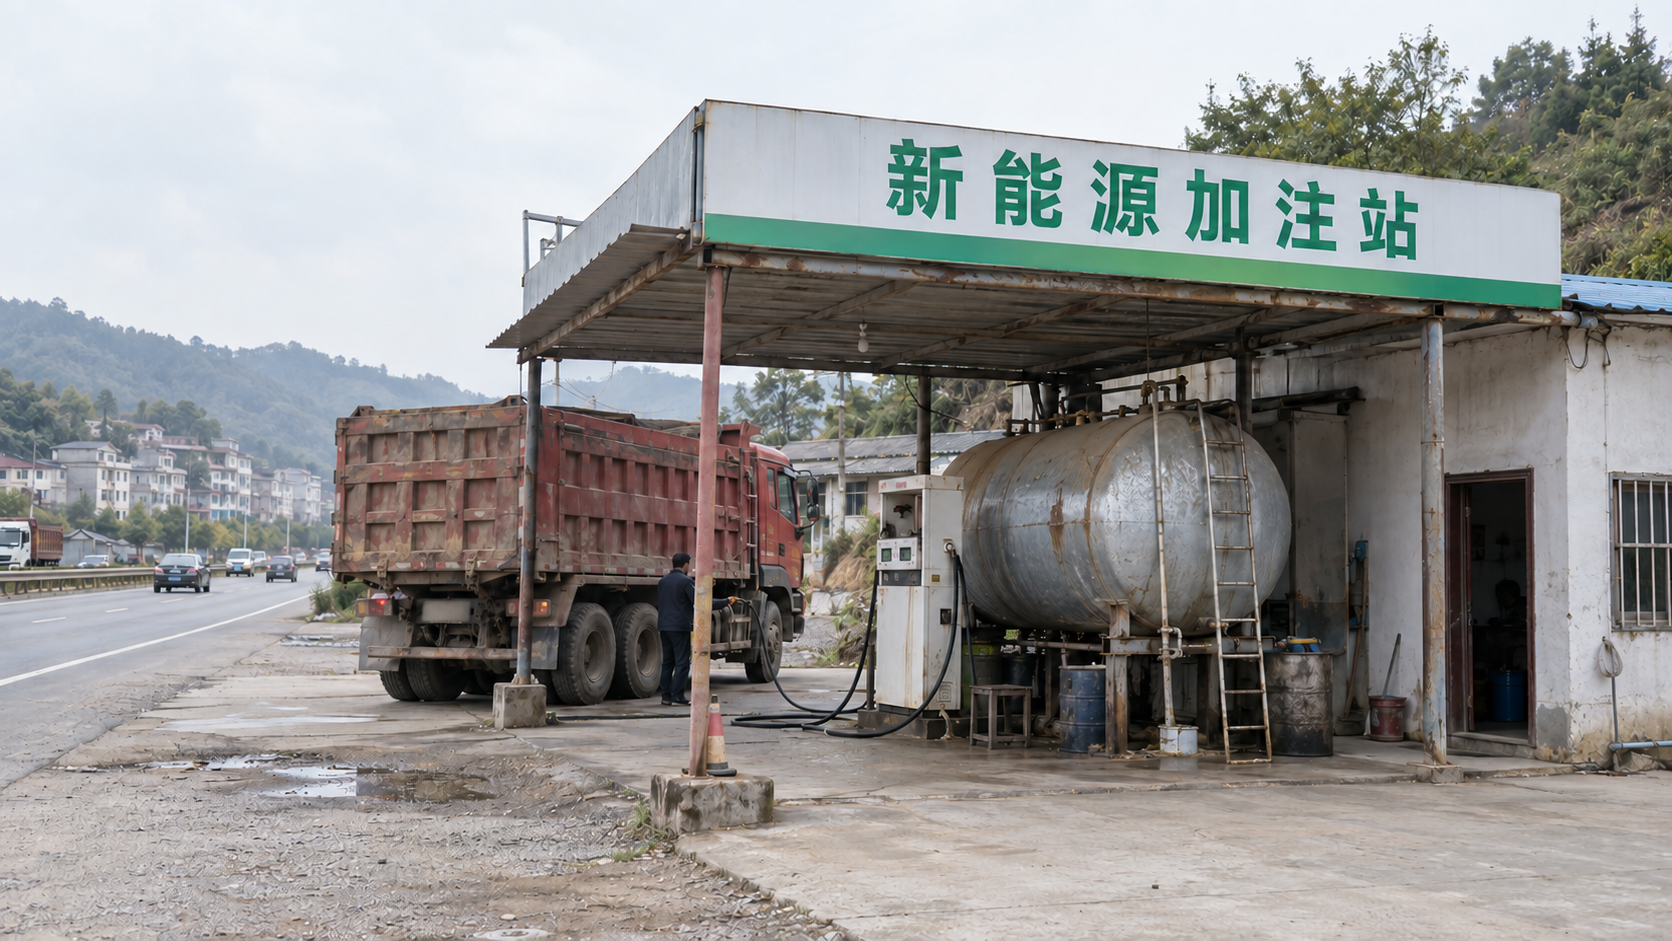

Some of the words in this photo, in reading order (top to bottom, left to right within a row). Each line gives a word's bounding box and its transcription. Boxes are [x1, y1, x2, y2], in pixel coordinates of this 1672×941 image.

[886, 138, 1419, 261] 新能源加注站
